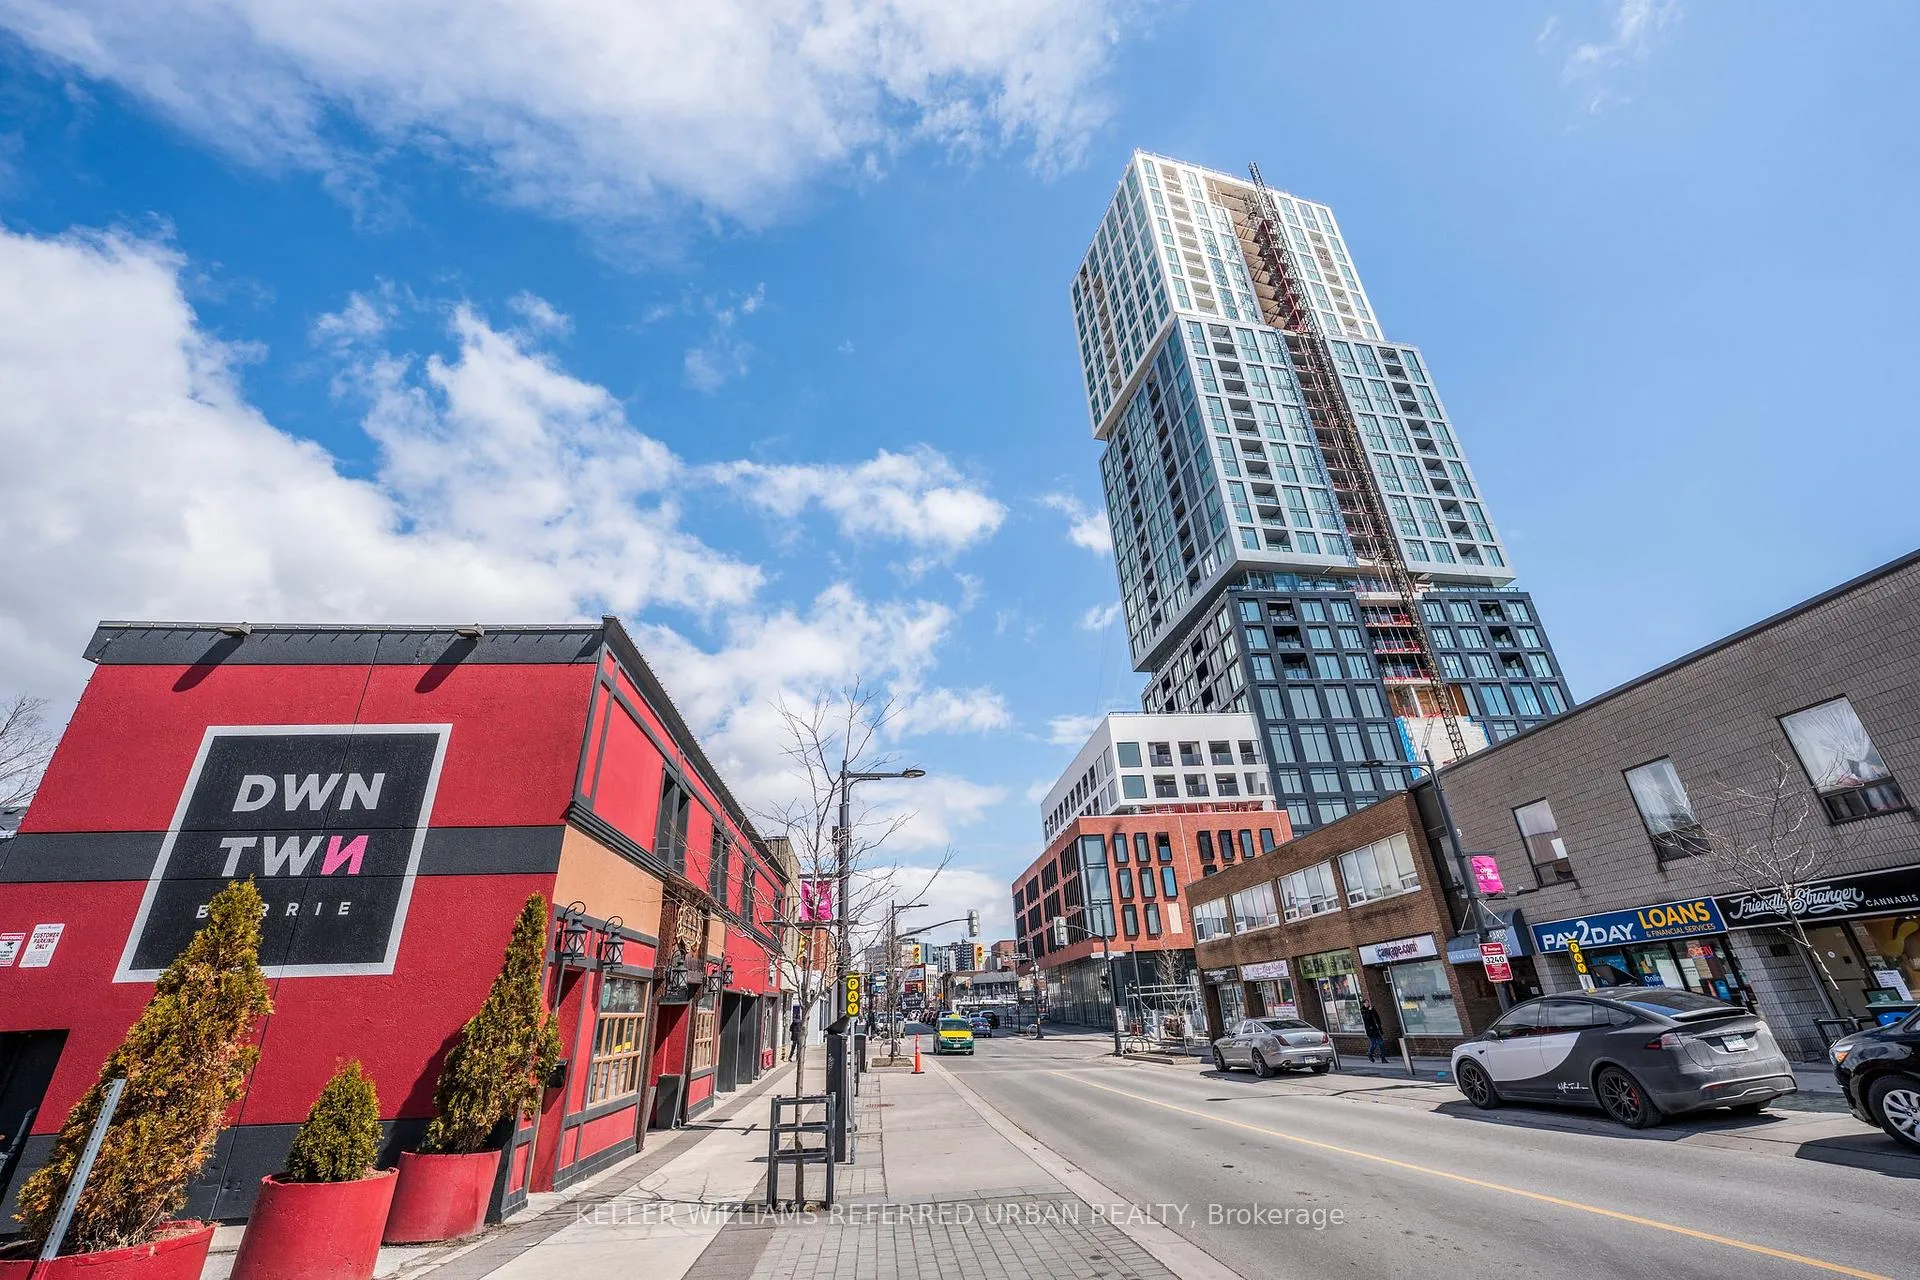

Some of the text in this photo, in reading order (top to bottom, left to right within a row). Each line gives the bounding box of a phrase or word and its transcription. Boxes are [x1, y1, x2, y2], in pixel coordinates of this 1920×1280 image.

[232, 772, 386, 812] DWN
[195, 901, 352, 919] BRRIE
[1637, 901, 1711, 930] LOANS
[1729, 885, 1919, 920] Friendly Stranger CANNABIS
[1651, 927, 1684, 937] FINANCIAL
[1684, 923, 1716, 933] SERVICES
[1485, 956, 1505, 964] 3240
[1571, 944, 1586, 973] PAY
[1644, 973, 1663, 983] Onlin
[849, 980, 858, 1013] PAY
